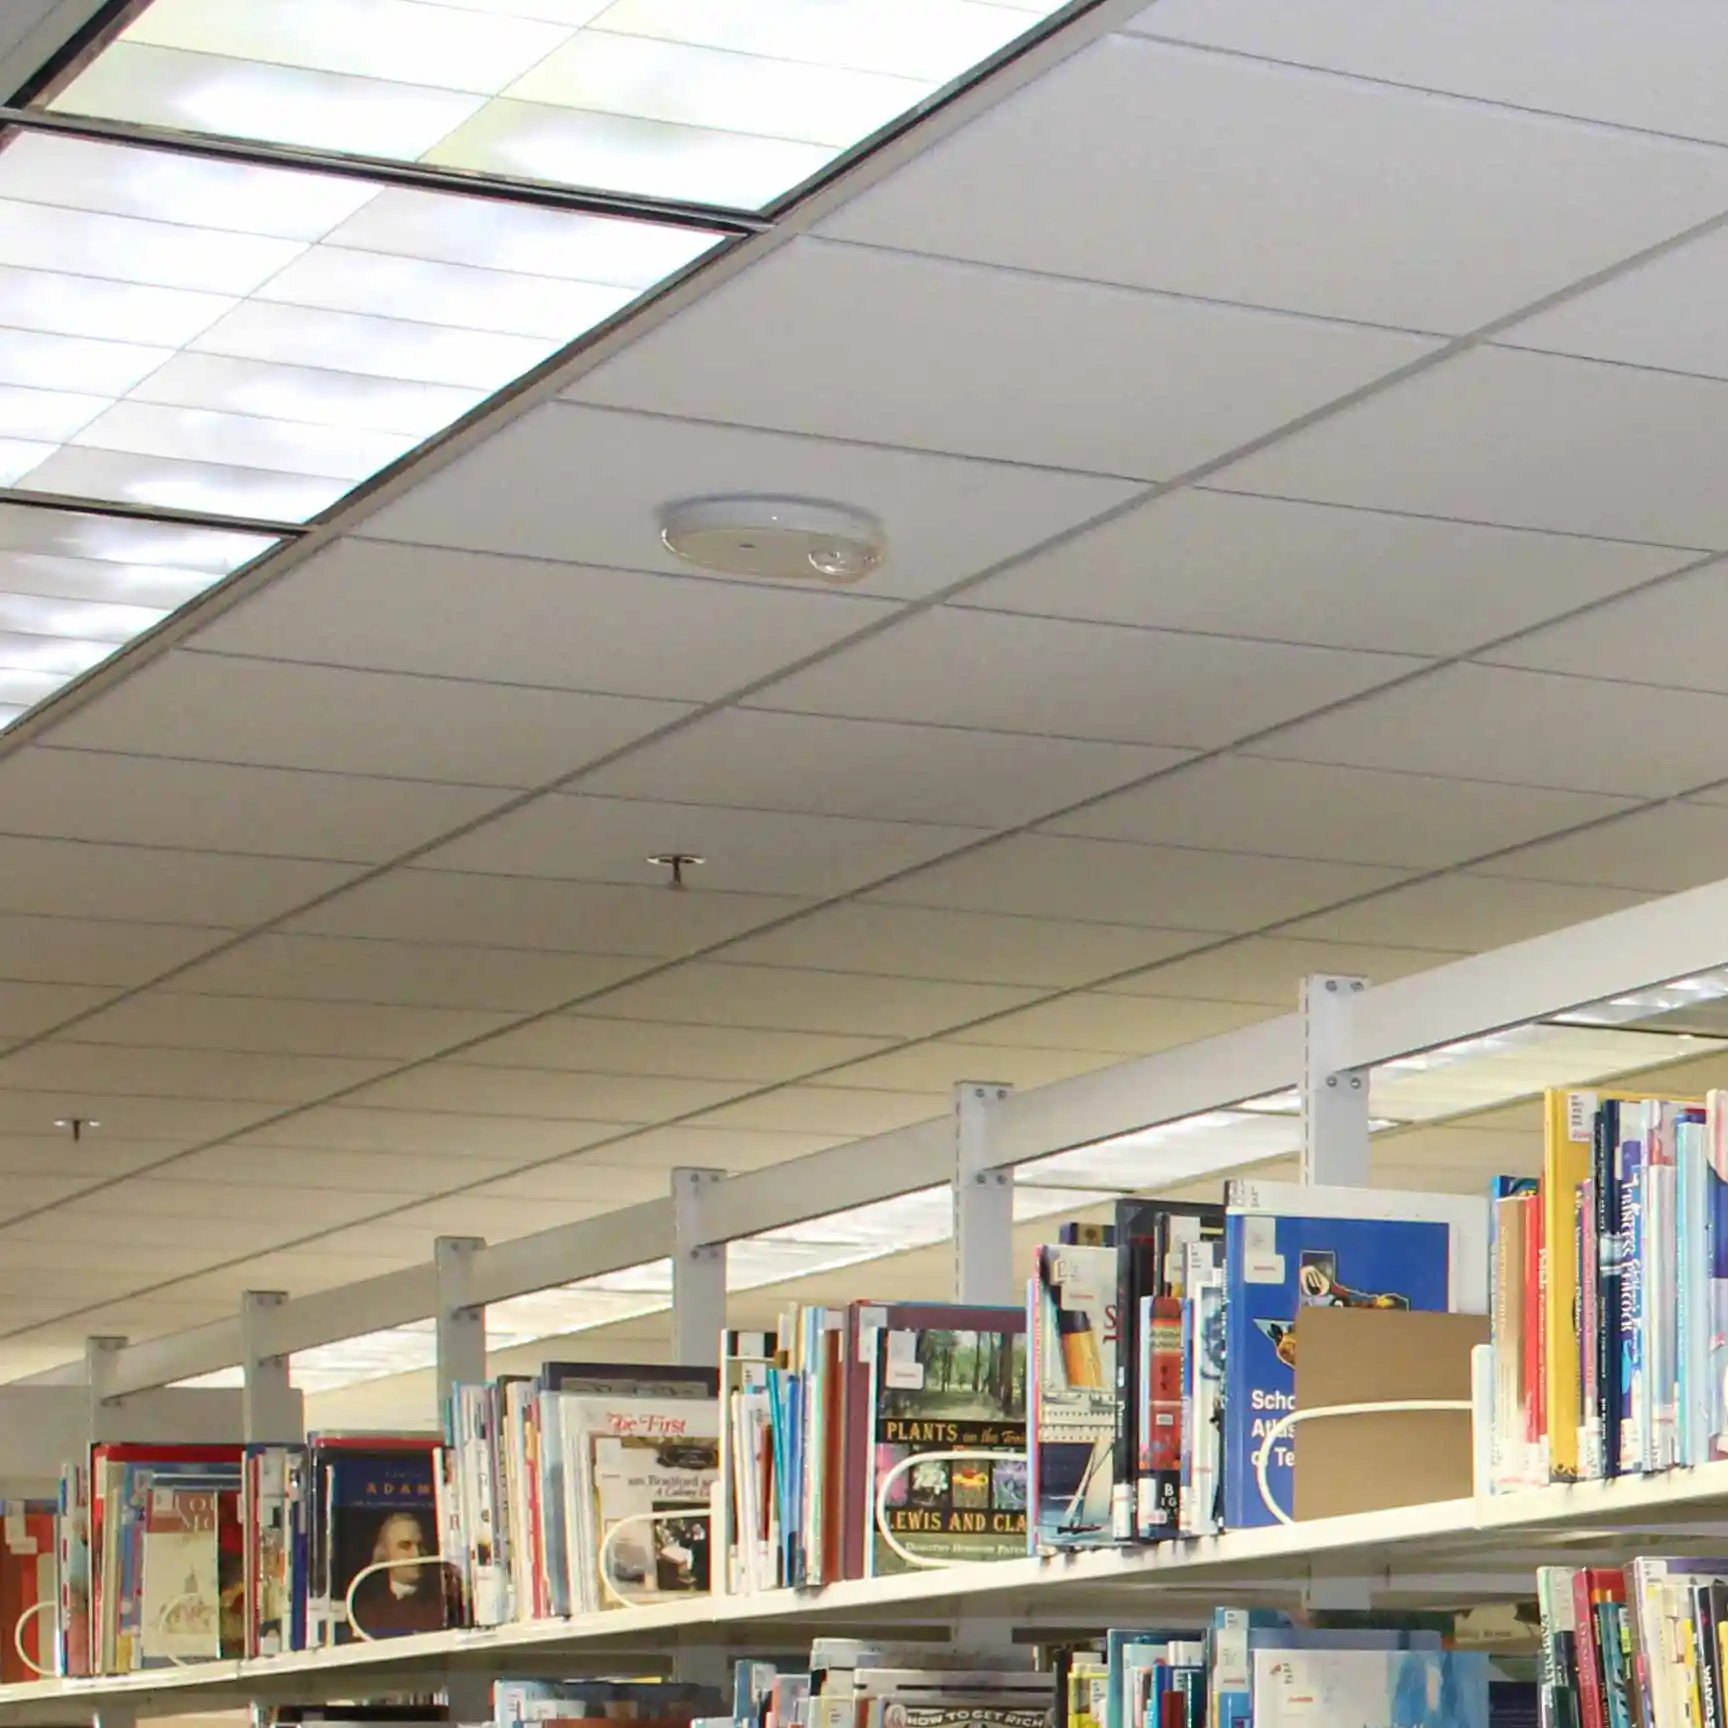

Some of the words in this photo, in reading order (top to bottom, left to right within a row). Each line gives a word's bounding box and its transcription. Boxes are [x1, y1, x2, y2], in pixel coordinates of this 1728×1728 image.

[639, 1414, 687, 1433] First
[886, 1422, 958, 1442] PLANTS
[949, 1512, 986, 1532] AND
[907, 1713, 943, 1726] HOW
[946, 1709, 970, 1721] TO
[972, 1709, 1004, 1720] GET
[1005, 1714, 1044, 1728] RICH
